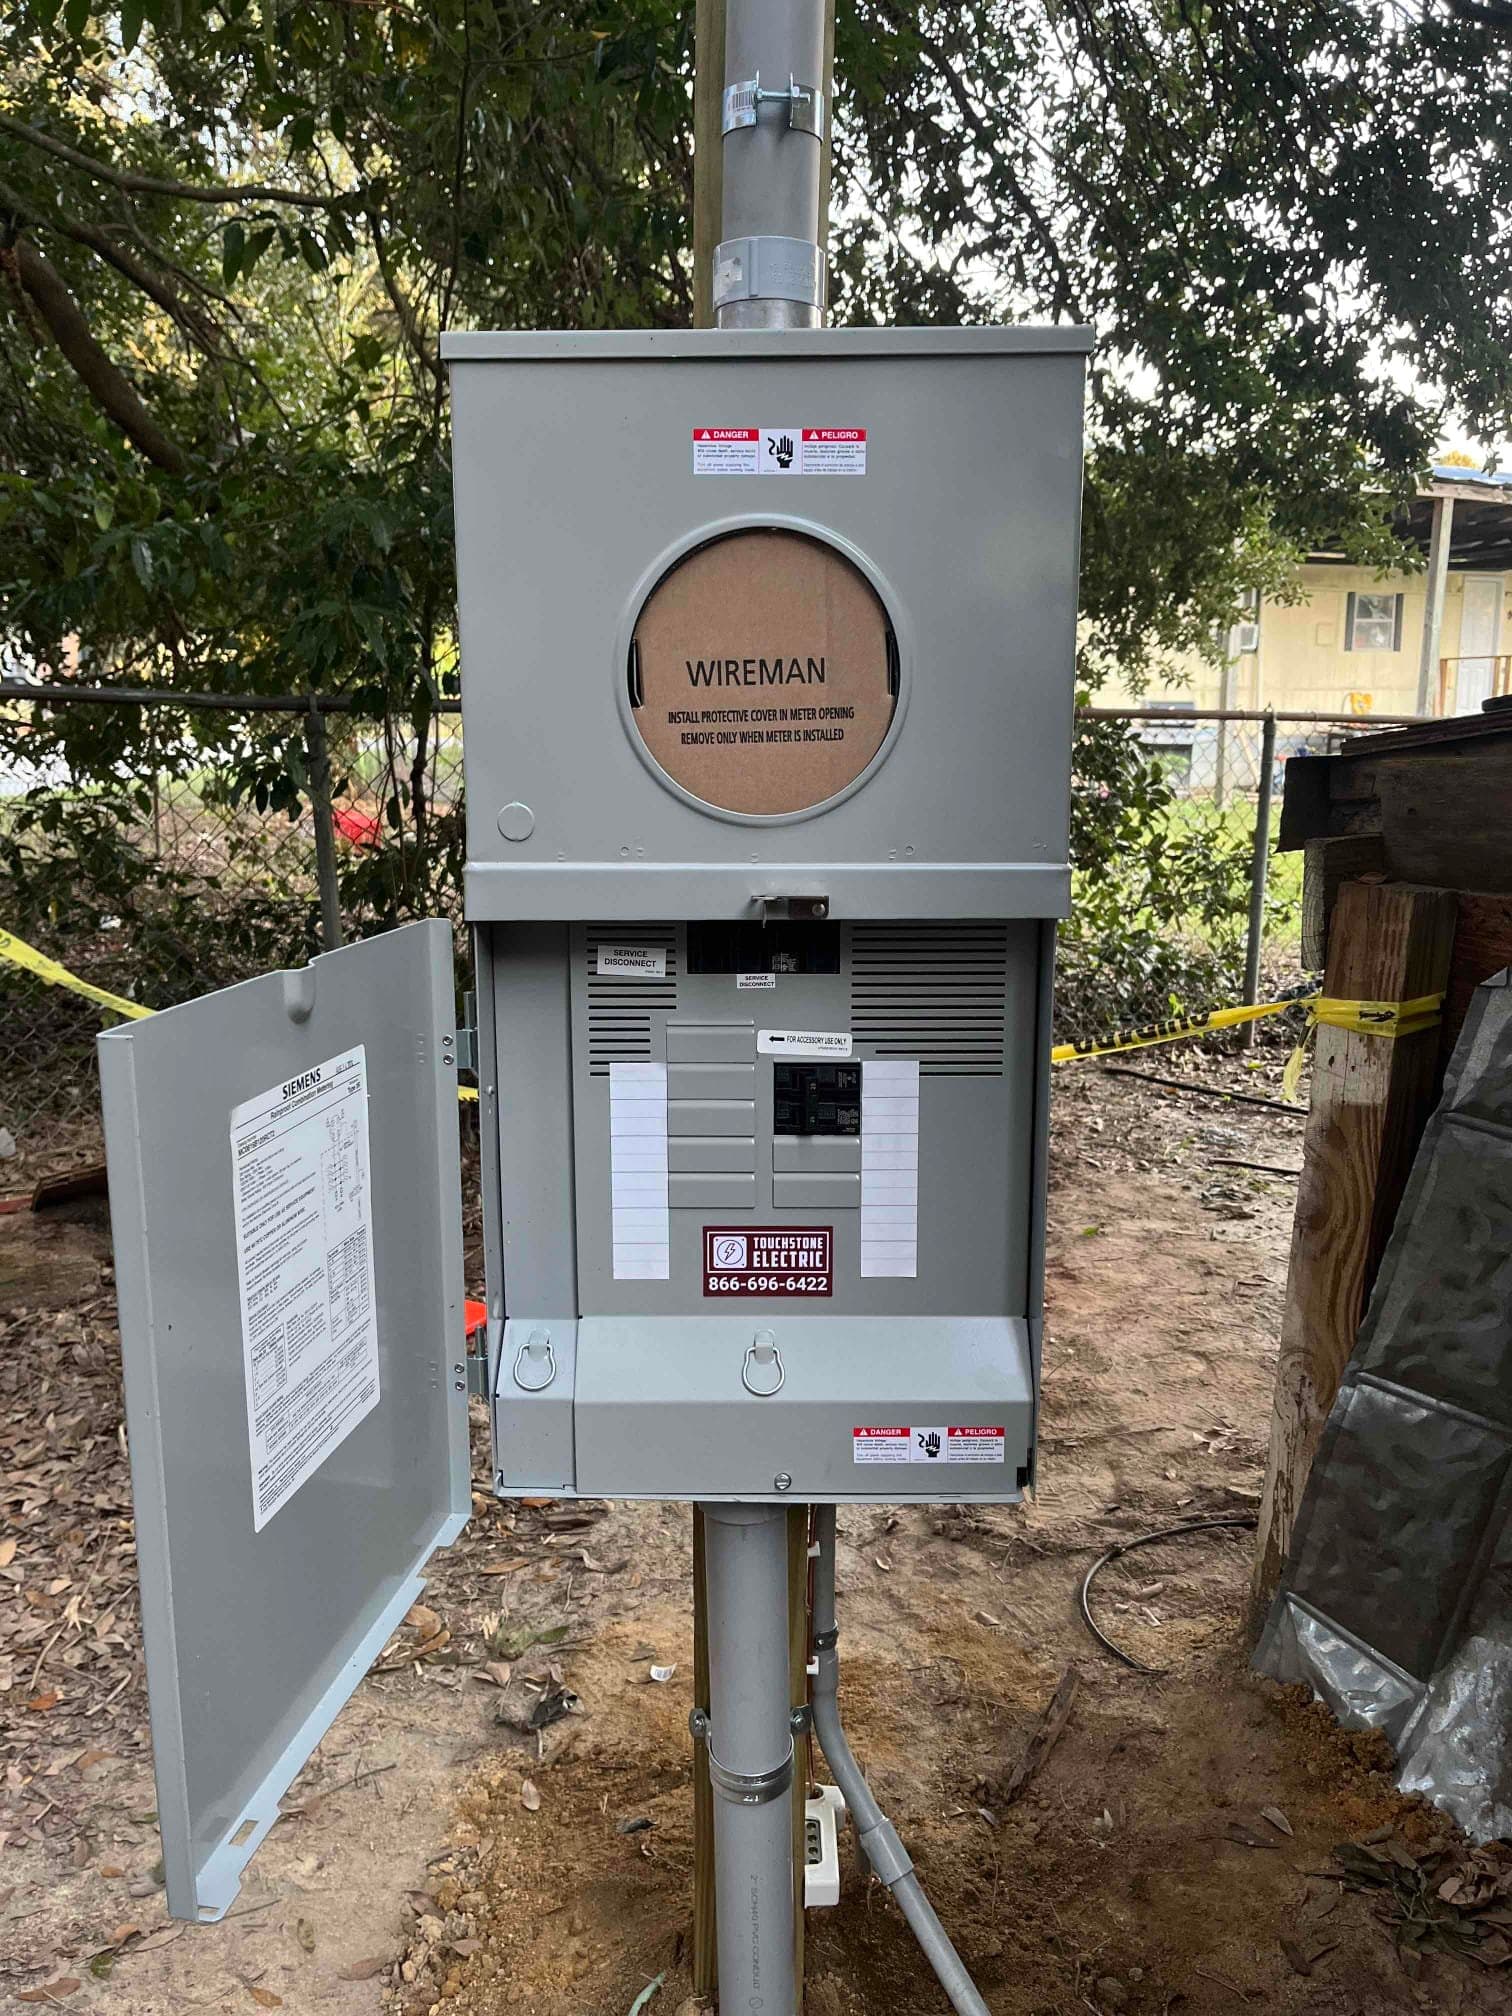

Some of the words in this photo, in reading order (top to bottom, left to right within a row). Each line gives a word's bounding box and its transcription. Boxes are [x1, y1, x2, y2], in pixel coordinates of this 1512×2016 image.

[713, 431, 749, 439] DANGER
[821, 431, 858, 440] PELIGRO
[686, 657, 825, 687] WIREMAN
[668, 711, 700, 724] INSTALL
[701, 710, 749, 723] PROTECTIVE
[751, 709, 778, 722] COVER
[779, 709, 788, 721] IN
[790, 708, 817, 720] METER
[819, 707, 855, 719] OPENING
[681, 732, 715, 745] REMOVE
[717, 732, 737, 744] ONLY
[738, 731, 764, 743] WHEN
[766, 730, 792, 742] METER
[794, 729, 801, 741] IS
[803, 728, 844, 741] INSTALLED
[613, 949, 649, 958] SERVICE
[604, 958, 657, 967] DISCONNECT
[797, 1036, 824, 1044] ACCESSORY
[282, 1068, 321, 1100] SIEMENS
[753, 1237, 823, 1249] TOUCHSTONE
[753, 1251, 823, 1267] ELECTRIC
[708, 1277, 828, 1291] 866-696-6422
[870, 1428, 902, 1436] DANGER
[964, 1428, 997, 1436] PELIGRO
